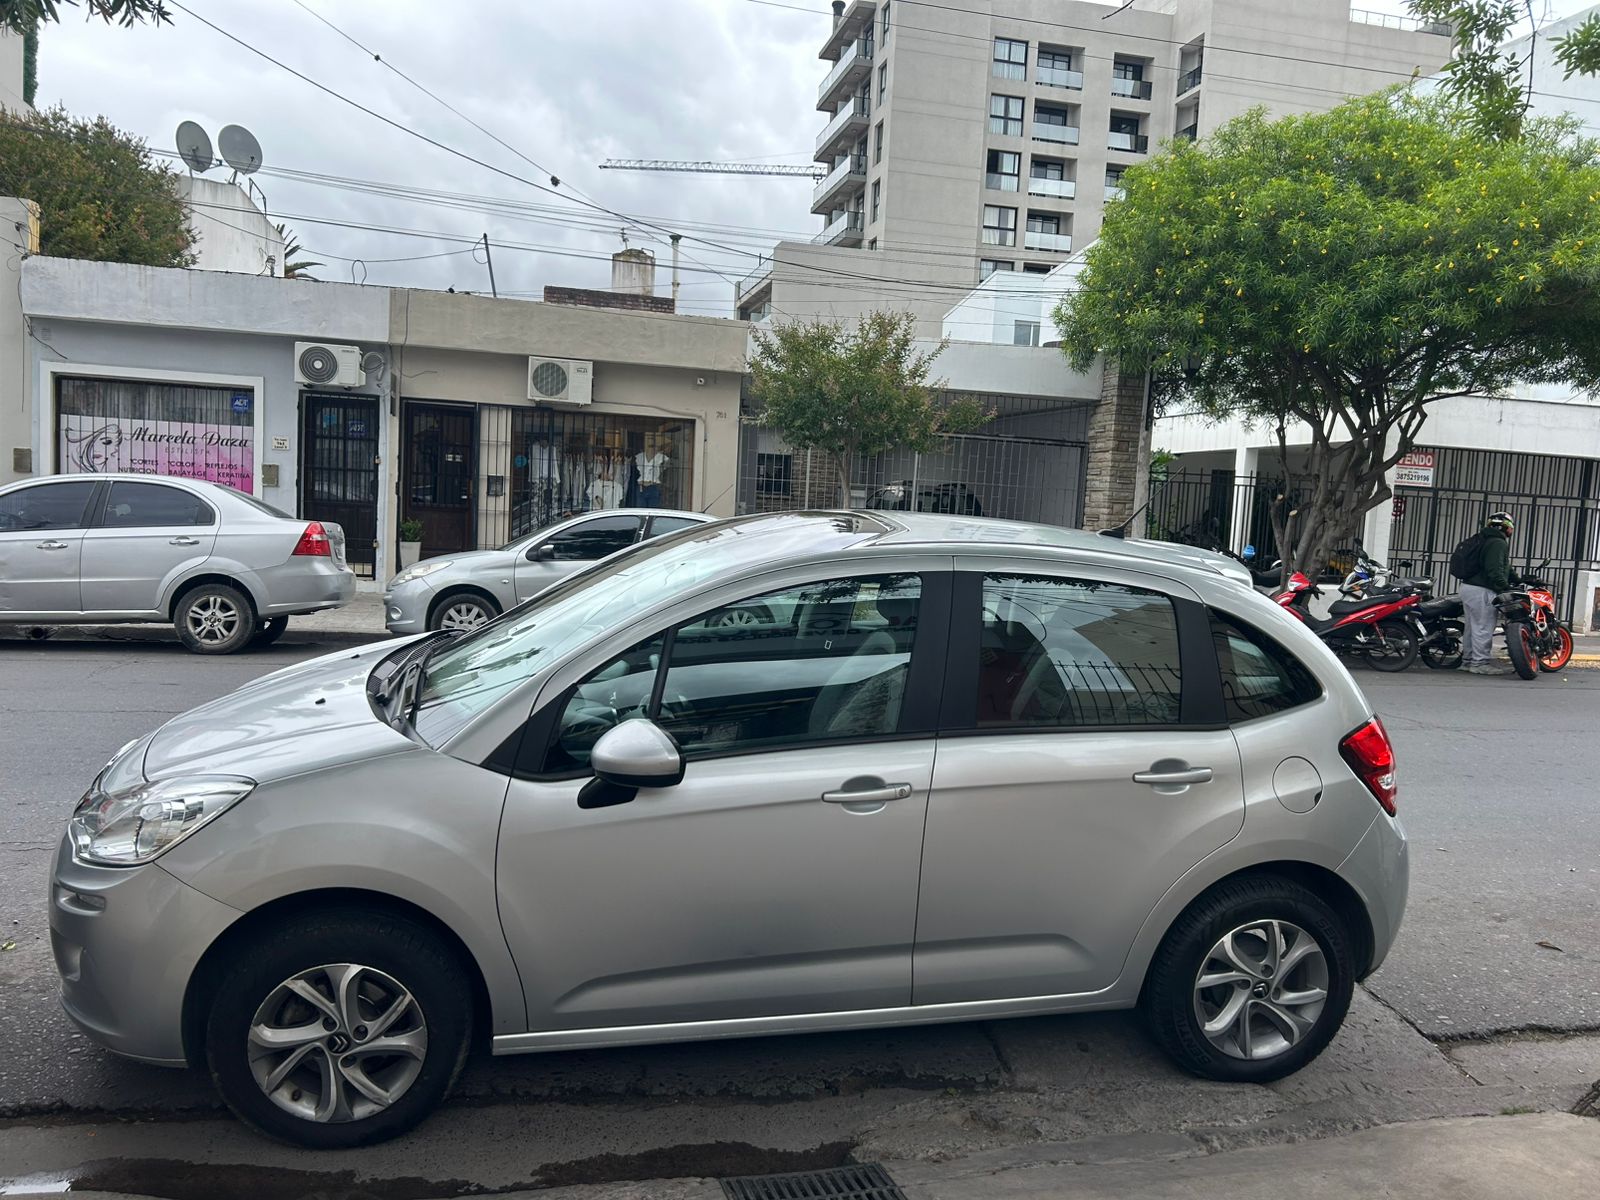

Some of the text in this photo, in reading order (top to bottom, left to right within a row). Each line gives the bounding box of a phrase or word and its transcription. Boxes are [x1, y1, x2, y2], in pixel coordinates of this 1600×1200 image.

[124, 426, 249, 448] Marcela Daza
[131, 458, 159, 466] CORTES
[169, 460, 195, 468] COLOR
